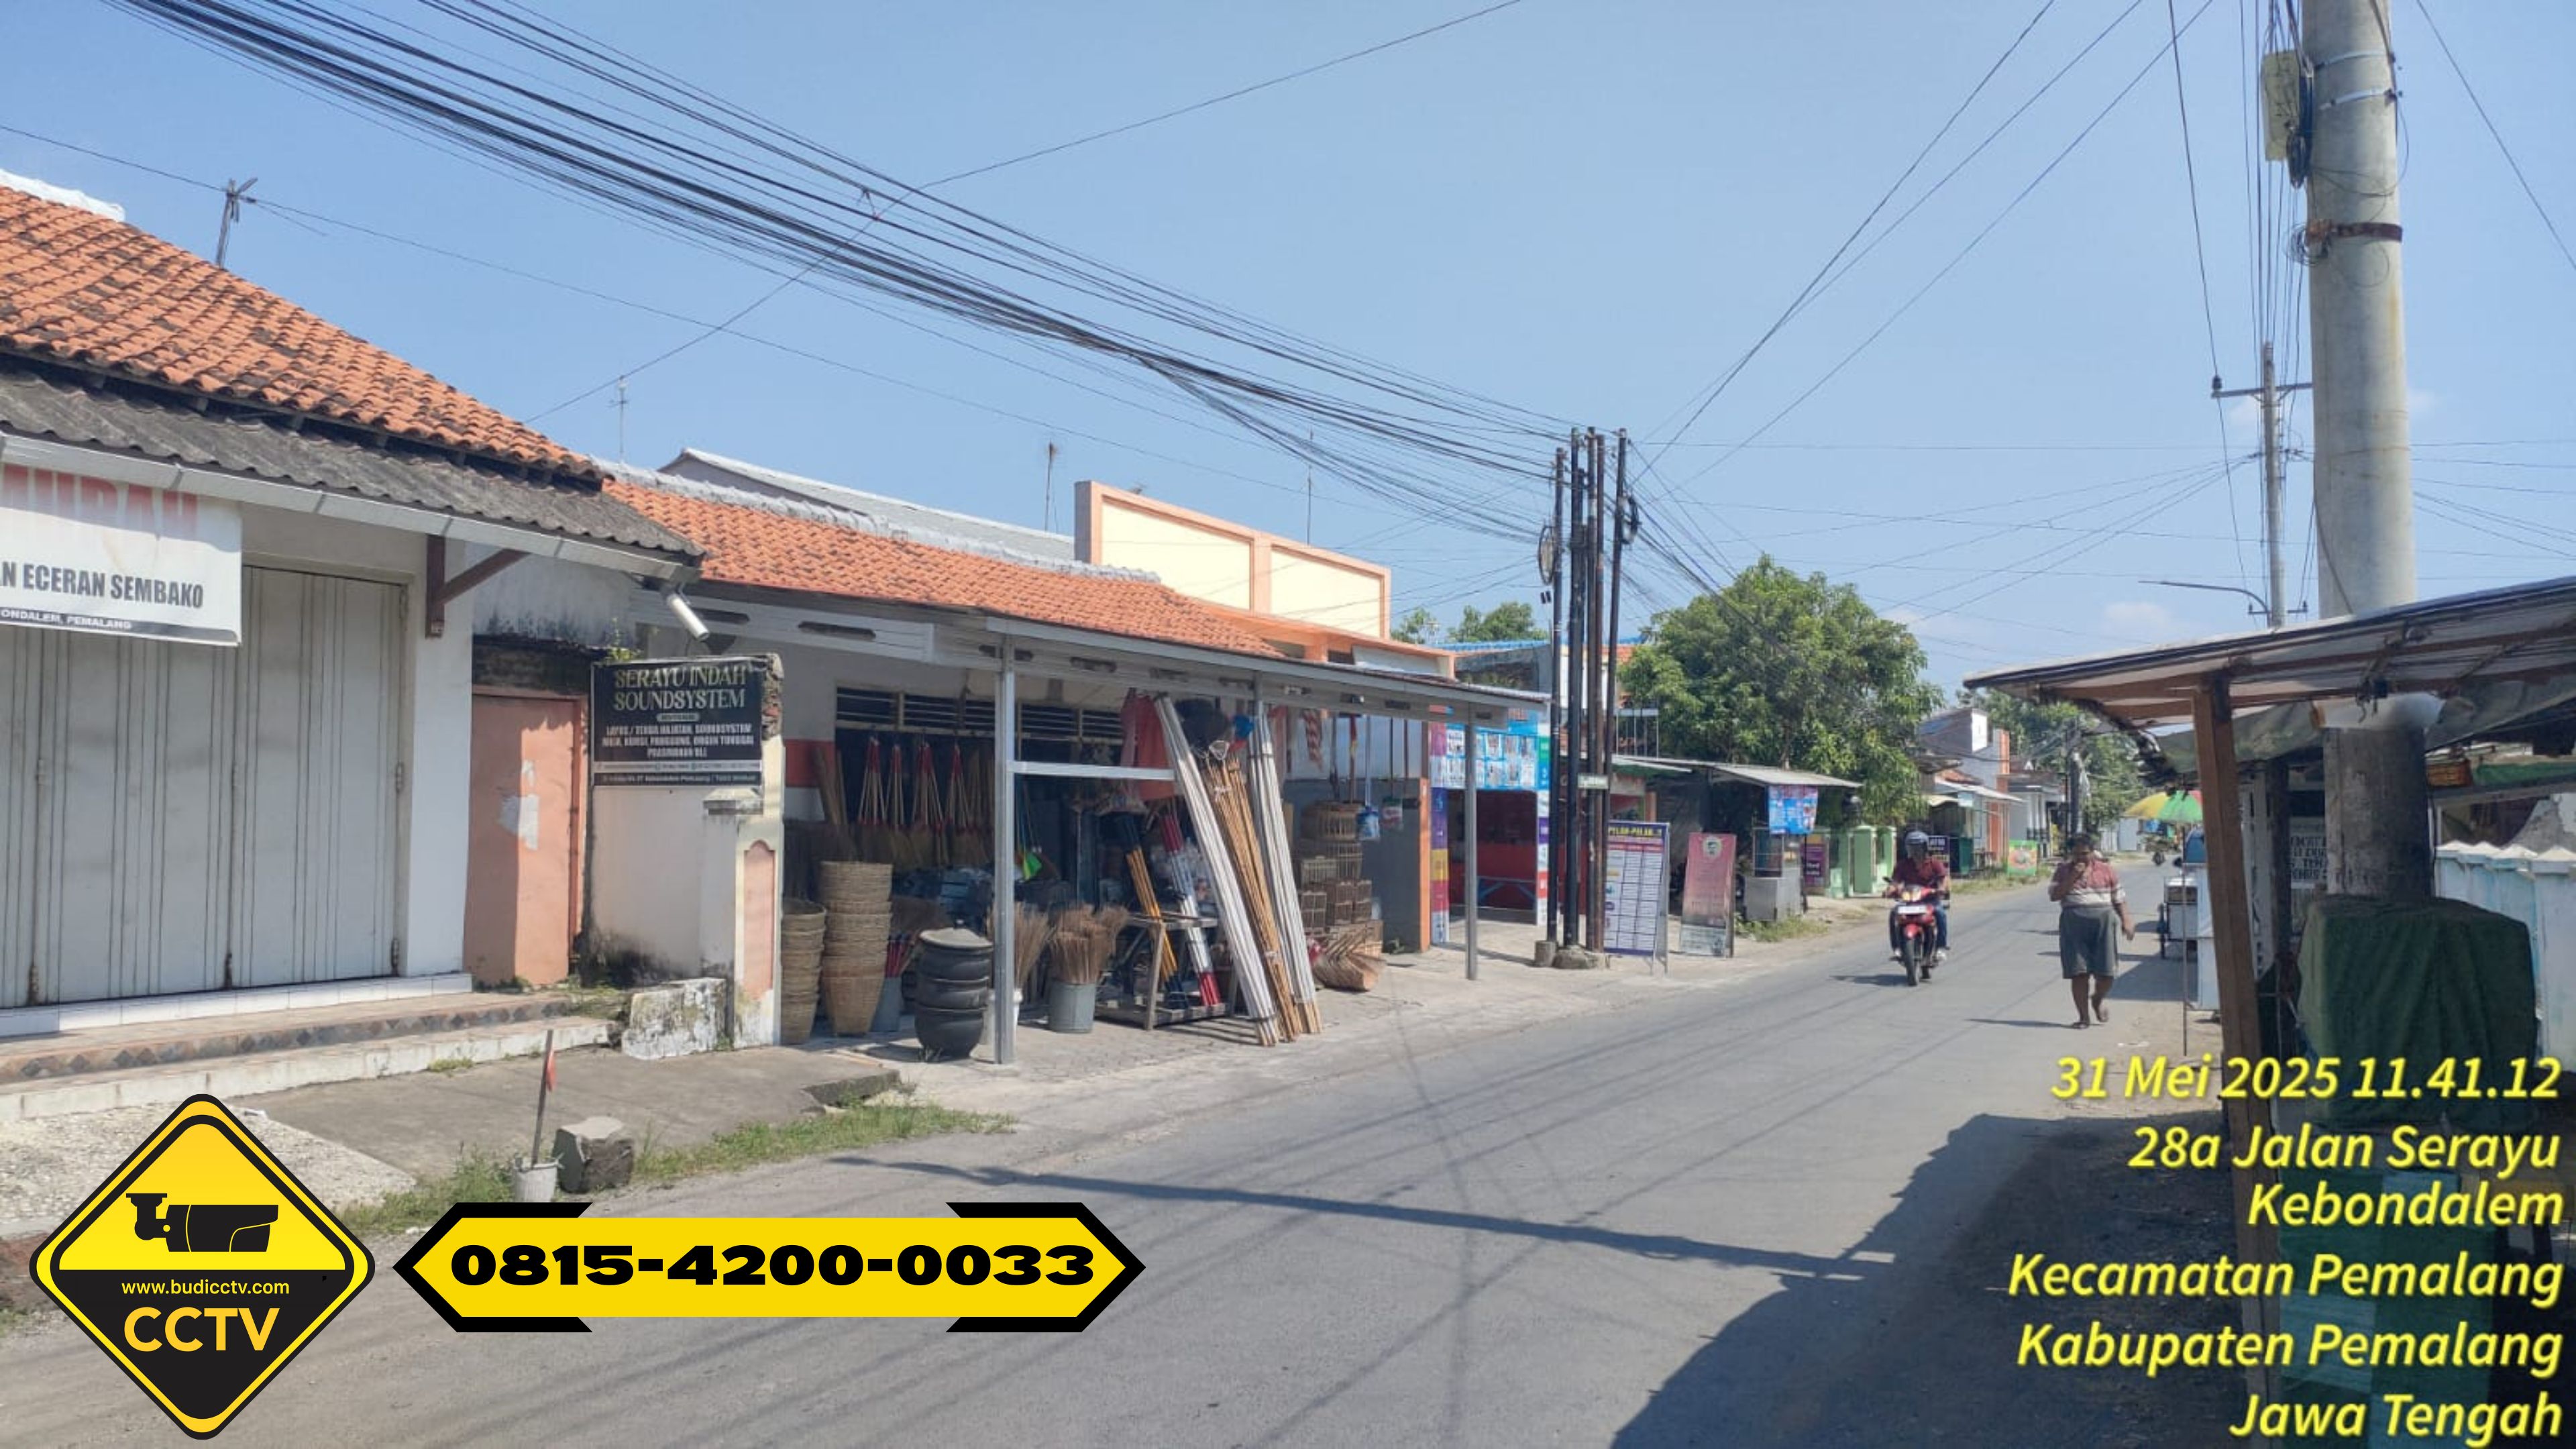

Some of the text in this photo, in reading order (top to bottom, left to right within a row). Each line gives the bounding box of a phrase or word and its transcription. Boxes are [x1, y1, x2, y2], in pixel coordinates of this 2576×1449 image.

[0, 561, 204, 609] N ECERAN SEMBAKO
[66, 616, 133, 631] PEMALANG
[615, 663, 747, 688] SERAYU INDAH
[614, 688, 745, 711] SOUNDSYSTEM
